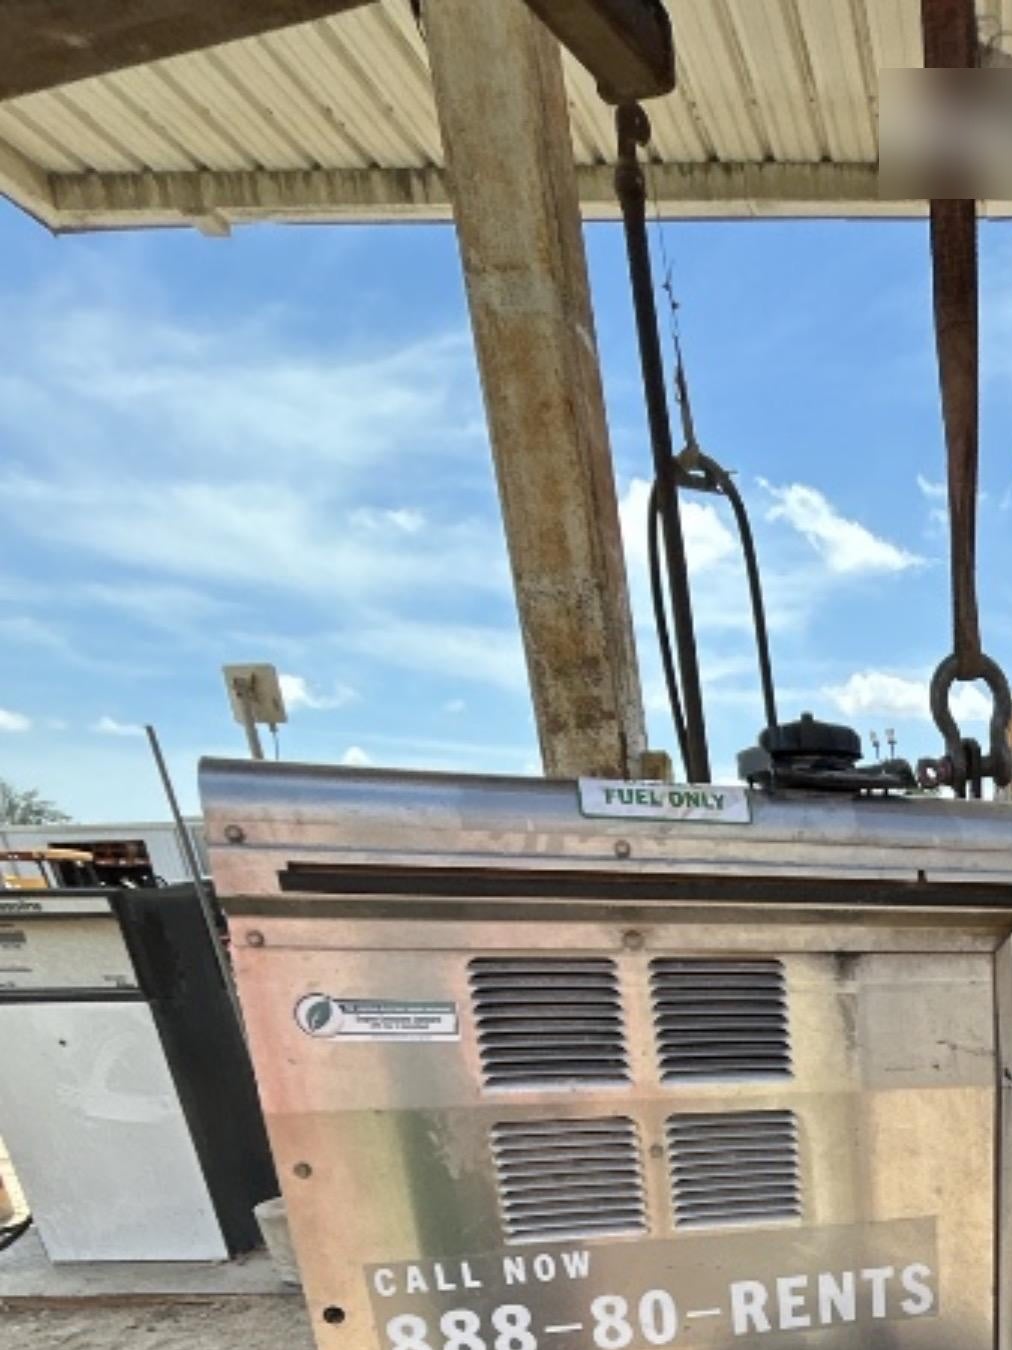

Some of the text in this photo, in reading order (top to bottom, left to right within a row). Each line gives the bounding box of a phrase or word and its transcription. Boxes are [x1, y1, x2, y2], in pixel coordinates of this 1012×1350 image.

[604, 787, 724, 810] FUEL ONLY
[373, 1250, 592, 1297] CALL NOW
